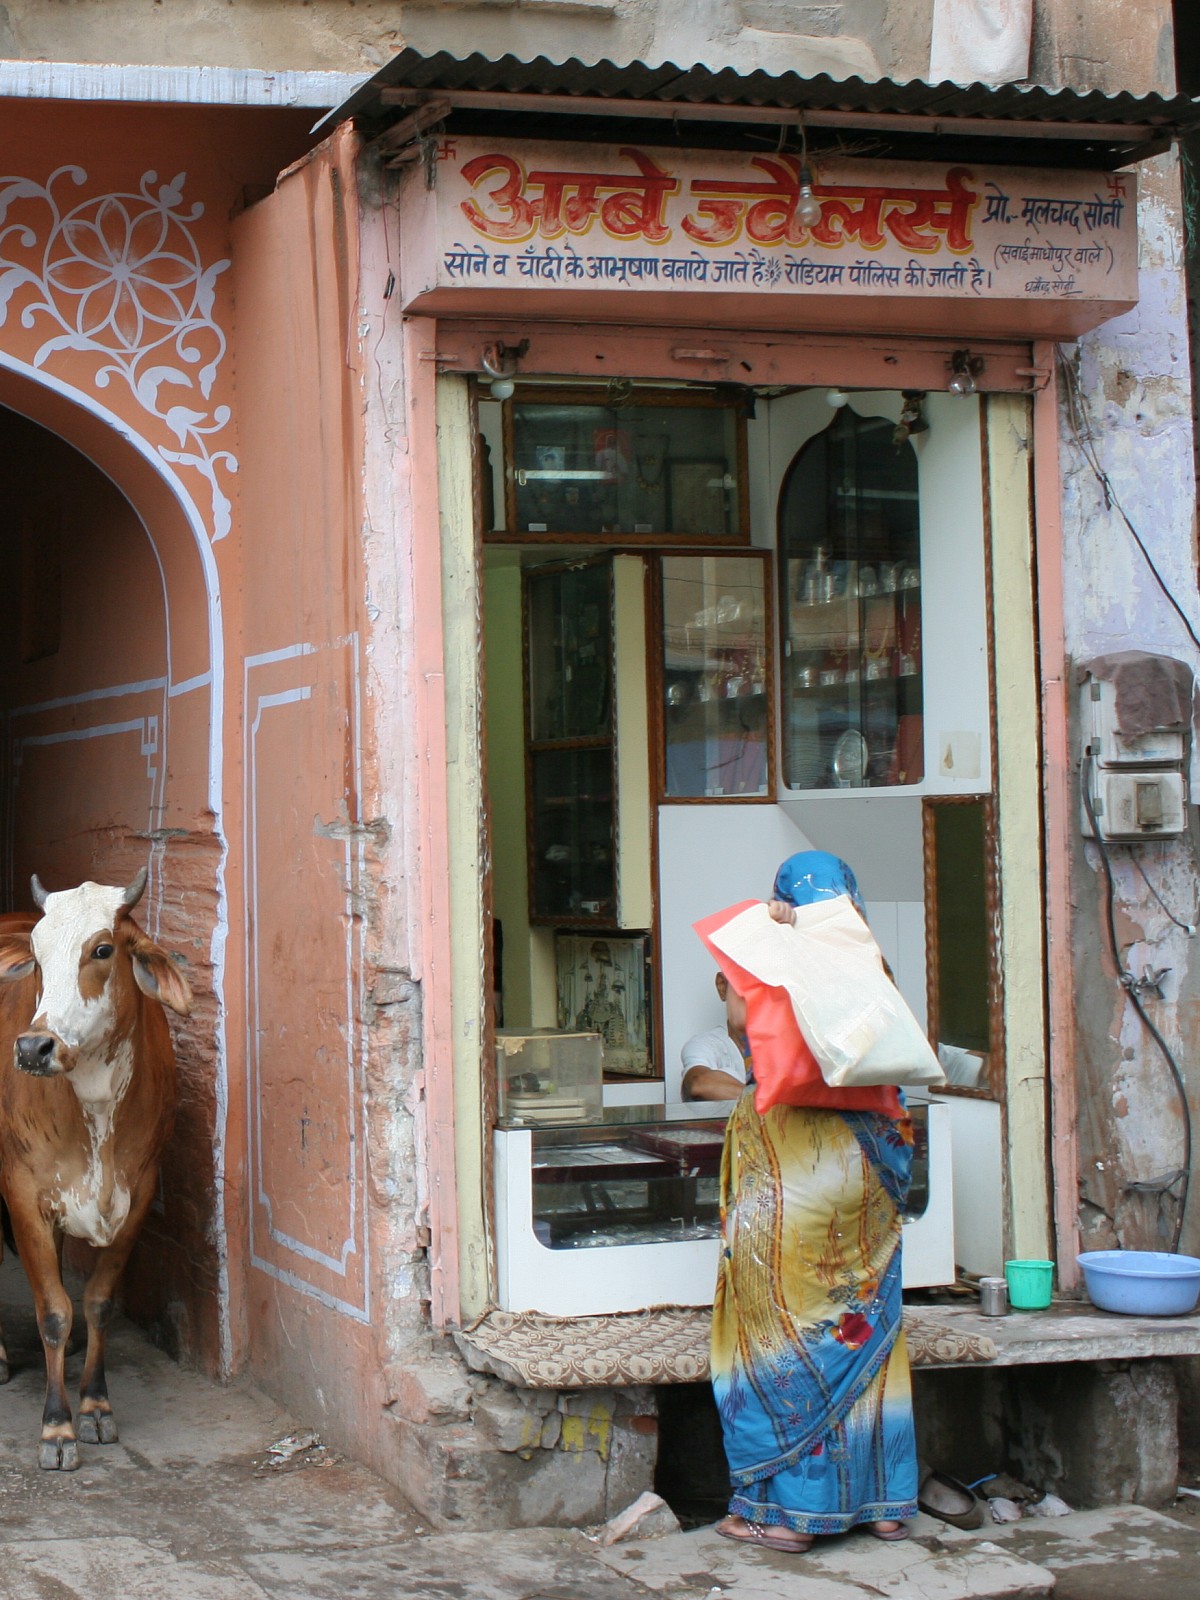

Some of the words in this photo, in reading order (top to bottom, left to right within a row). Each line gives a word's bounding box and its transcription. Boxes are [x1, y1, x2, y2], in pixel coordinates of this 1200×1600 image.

[459, 147, 680, 245] अम्बे
[1021, 198, 1081, 234] मूलचन्द
[1083, 194, 1124, 231] सोनी
[444, 243, 490, 278] सोने
[493, 254, 510, 278] व
[564, 245, 584, 279] के
[586, 256, 660, 288] आभूषण
[662, 251, 710, 284] बनाये
[711, 252, 750, 284] जाते
[748, 248, 766, 288] हैं
[785, 254, 846, 286] रोडियम
[848, 260, 901, 288] पॉलिस
[904, 259, 928, 288] की
[927, 261, 968, 290] जाती
